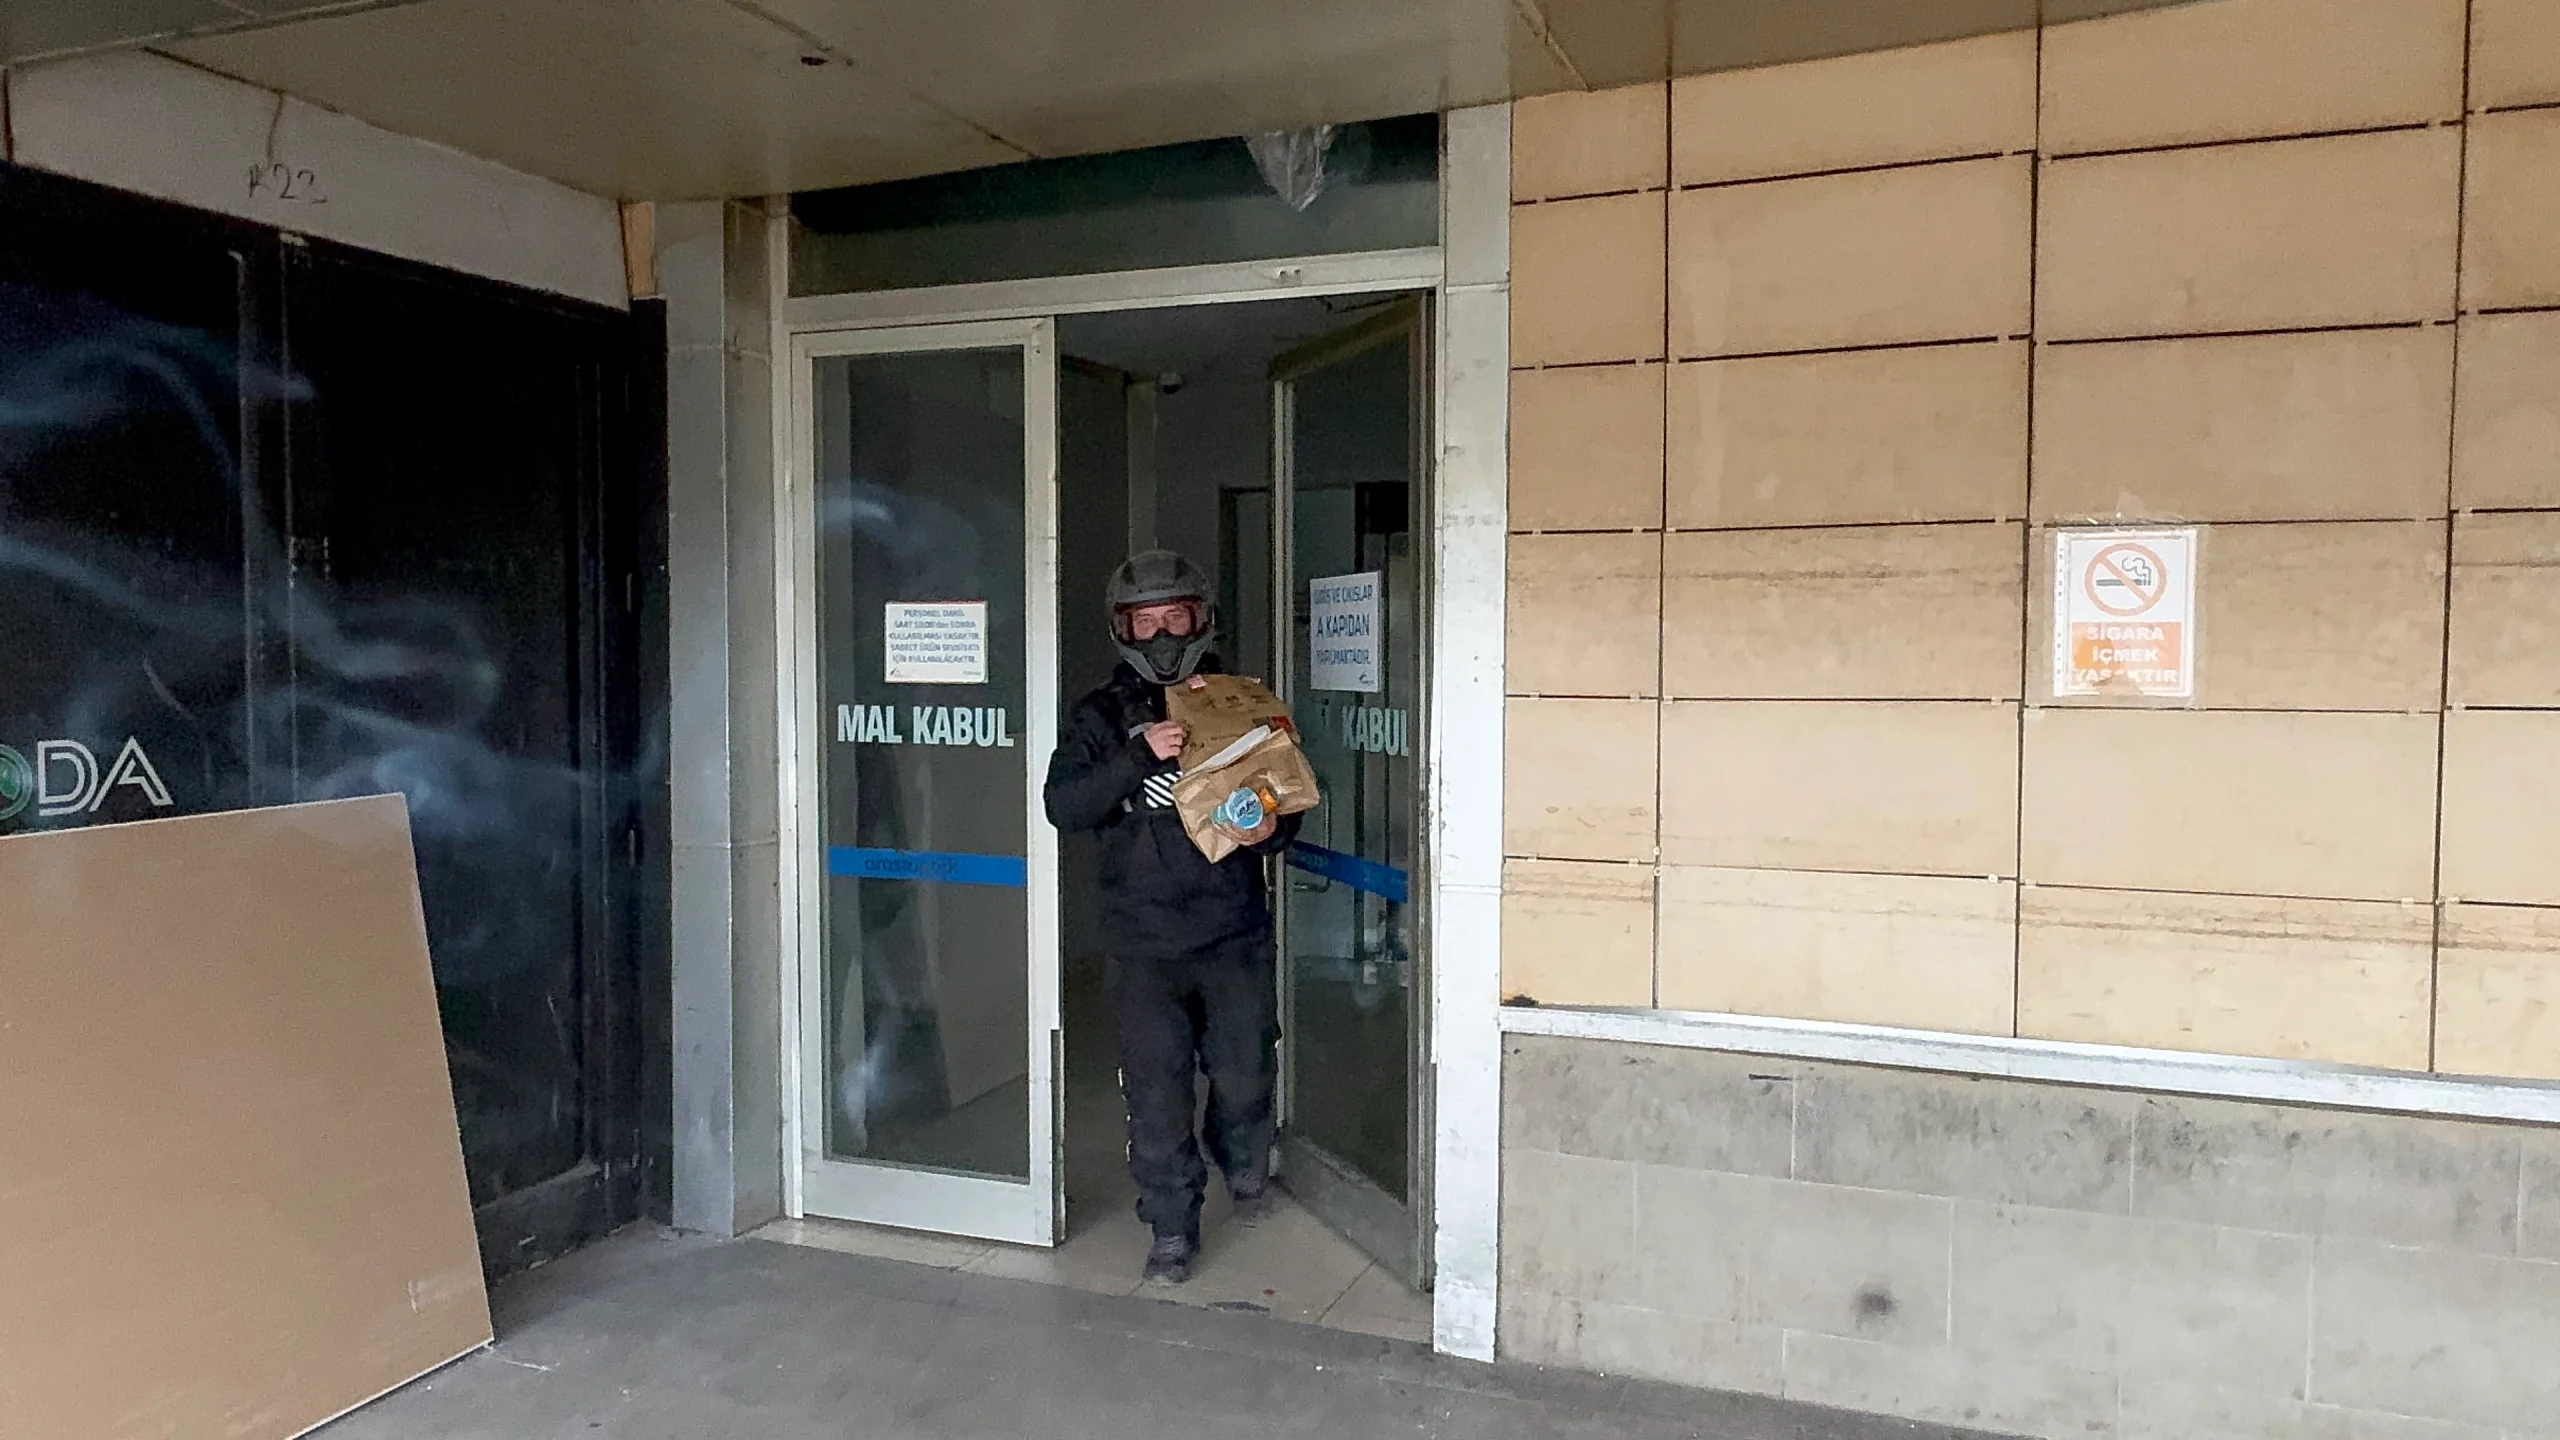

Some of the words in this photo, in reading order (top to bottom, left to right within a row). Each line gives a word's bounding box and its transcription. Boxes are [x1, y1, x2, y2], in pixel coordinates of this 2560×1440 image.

[1317, 616, 1324, 637] A
[1326, 613, 1370, 637] KAPIDAN
[2092, 646, 2159, 665] İÇMEK
[837, 704, 903, 743] MAL
[912, 705, 1014, 747] KABUL
[1342, 705, 1409, 757] KABUL
